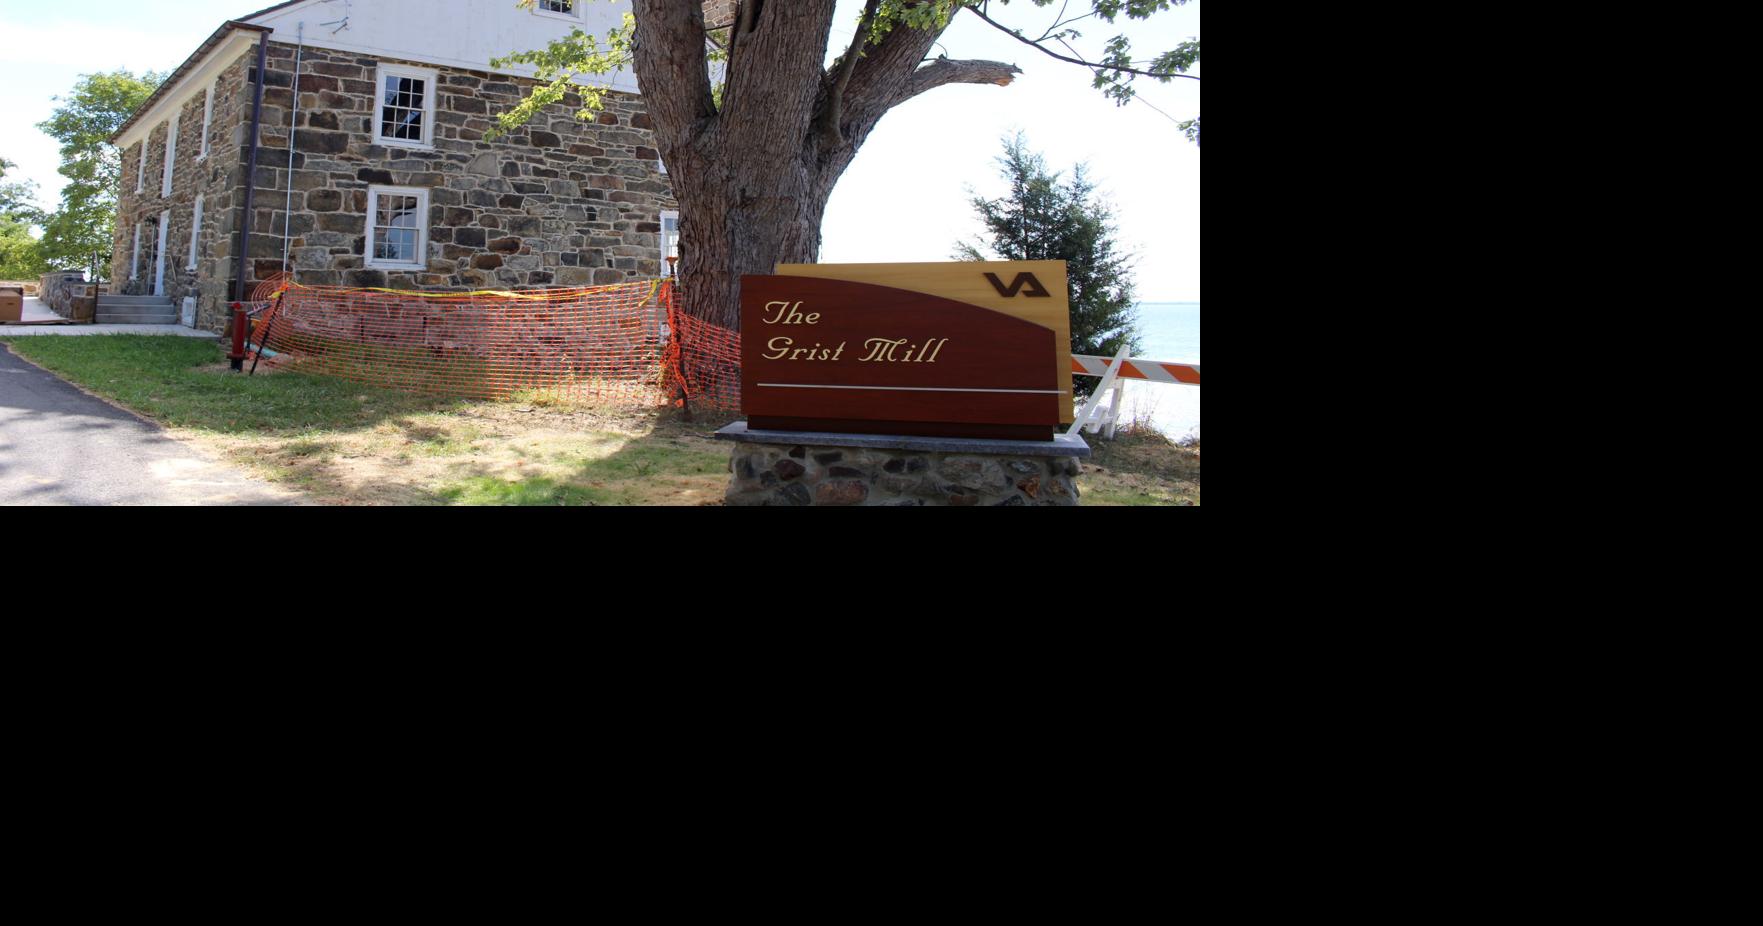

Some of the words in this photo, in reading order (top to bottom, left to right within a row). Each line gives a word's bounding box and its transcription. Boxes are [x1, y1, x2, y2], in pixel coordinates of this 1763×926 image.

[983, 271, 1051, 298] VA
[762, 300, 821, 325] The
[761, 336, 846, 361] Grist
[858, 337, 949, 363] Mill
